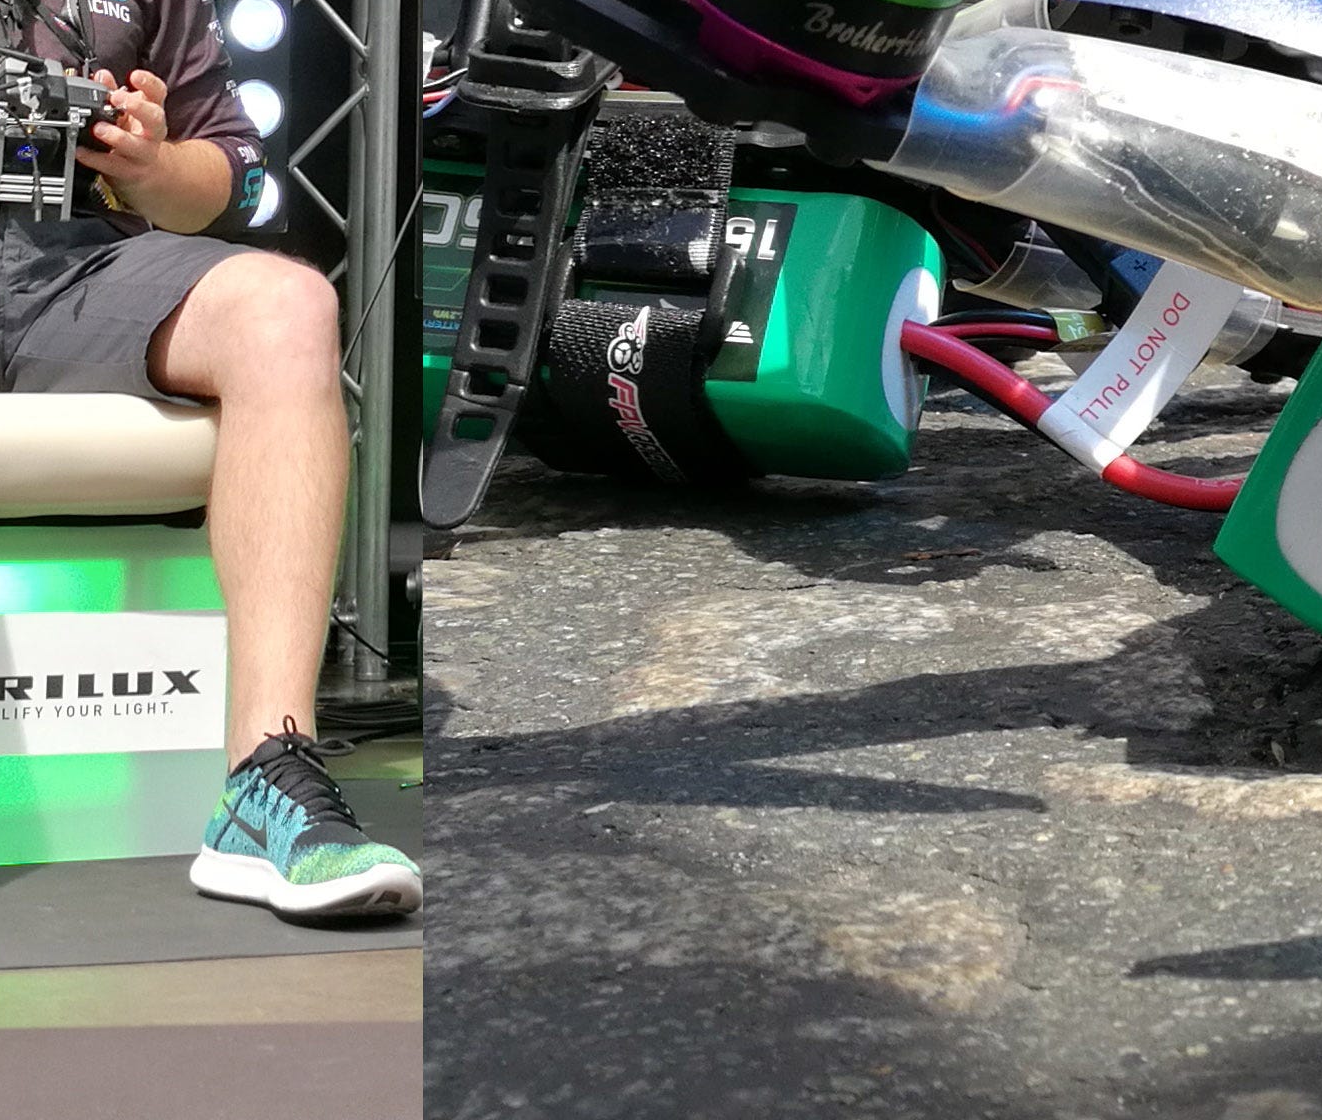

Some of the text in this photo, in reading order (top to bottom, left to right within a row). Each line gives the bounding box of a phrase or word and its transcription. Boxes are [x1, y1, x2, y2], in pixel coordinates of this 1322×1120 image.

[1079, 291, 1191, 421] DO NOT PULL
[54, 704, 103, 718] YOUR
[114, 701, 174, 716] LIGHT.
